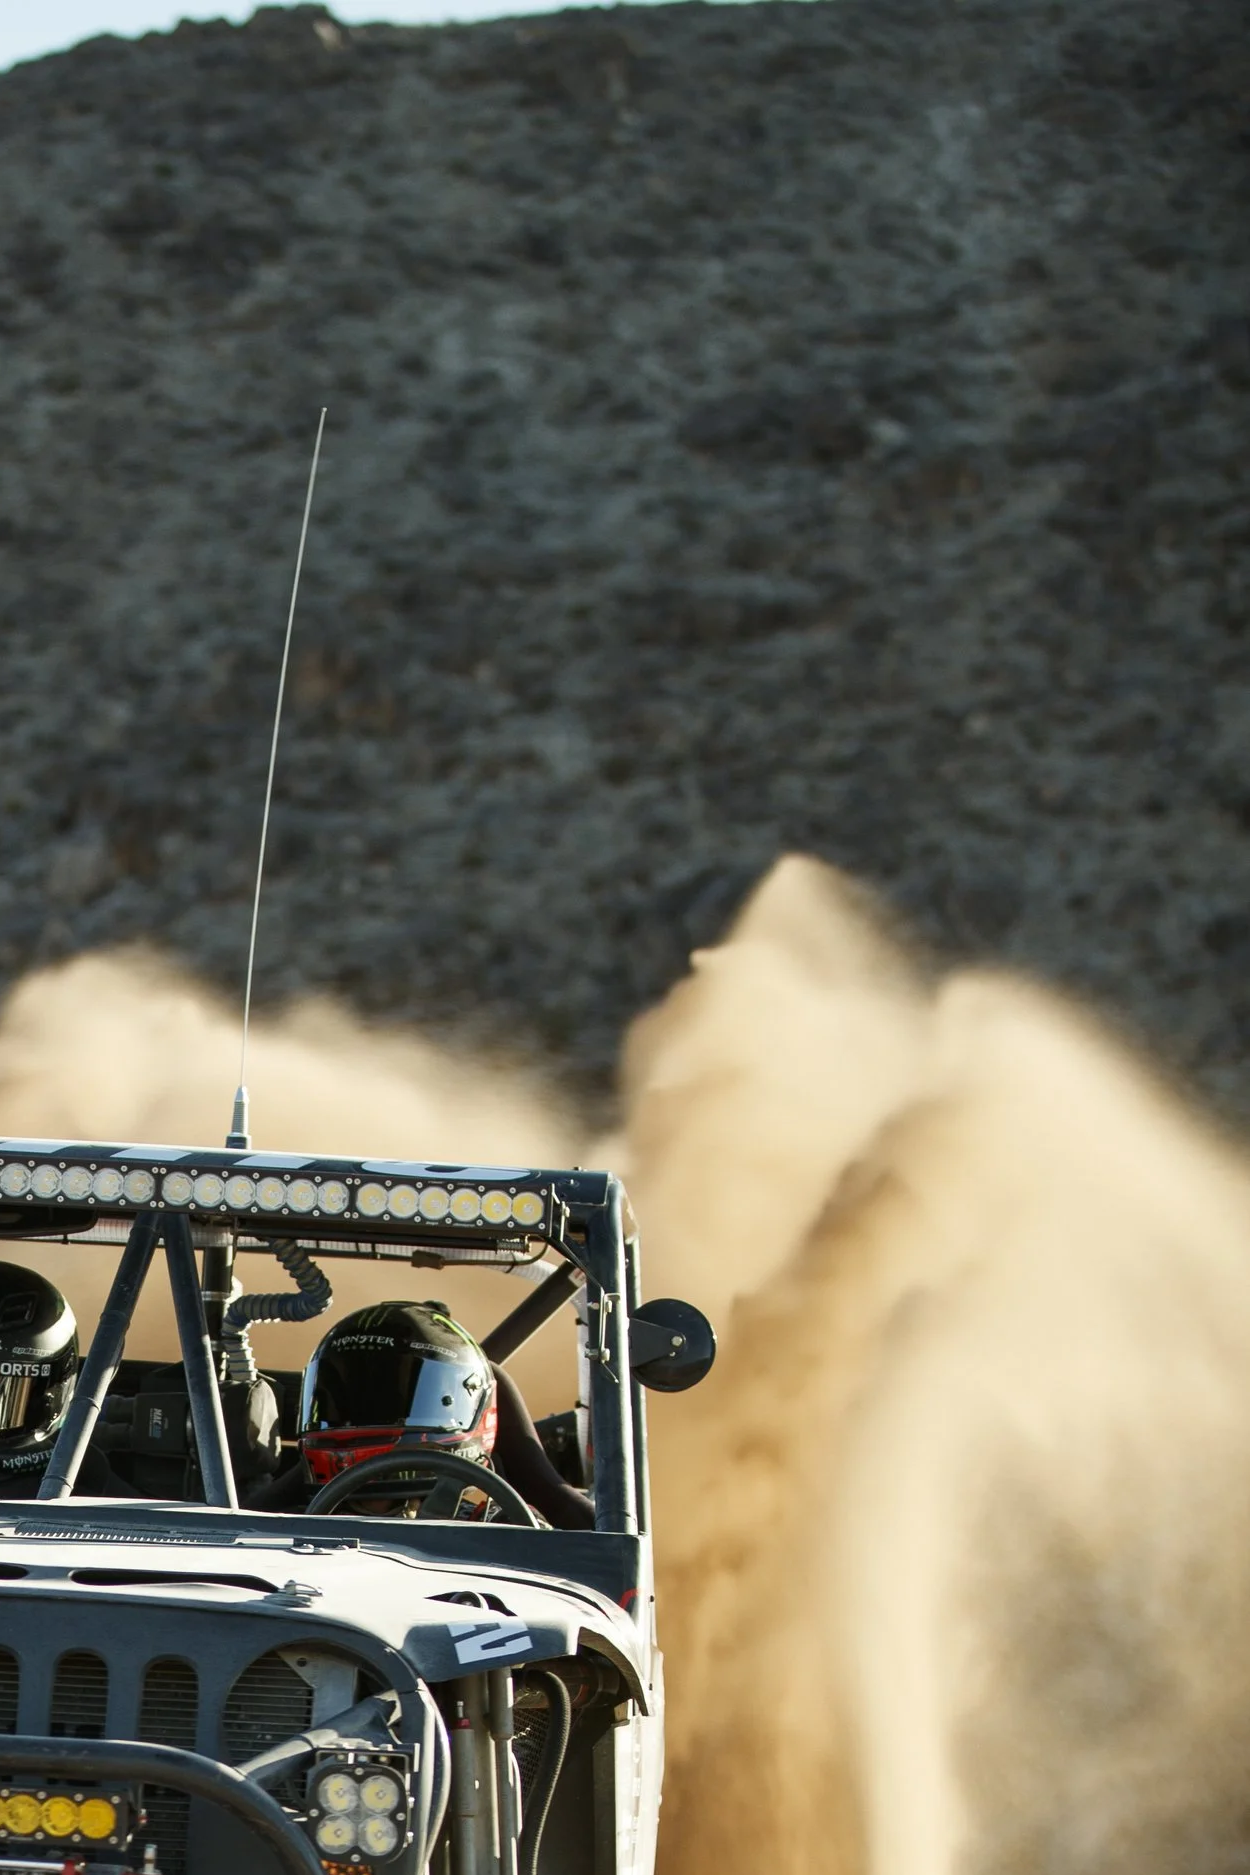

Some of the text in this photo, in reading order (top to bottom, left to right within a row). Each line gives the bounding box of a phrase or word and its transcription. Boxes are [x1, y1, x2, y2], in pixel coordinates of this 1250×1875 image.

[331, 1334, 394, 1347] MONSTER
[2, 1448, 54, 1469] MONSTE
[447, 1618, 533, 1665] 2
